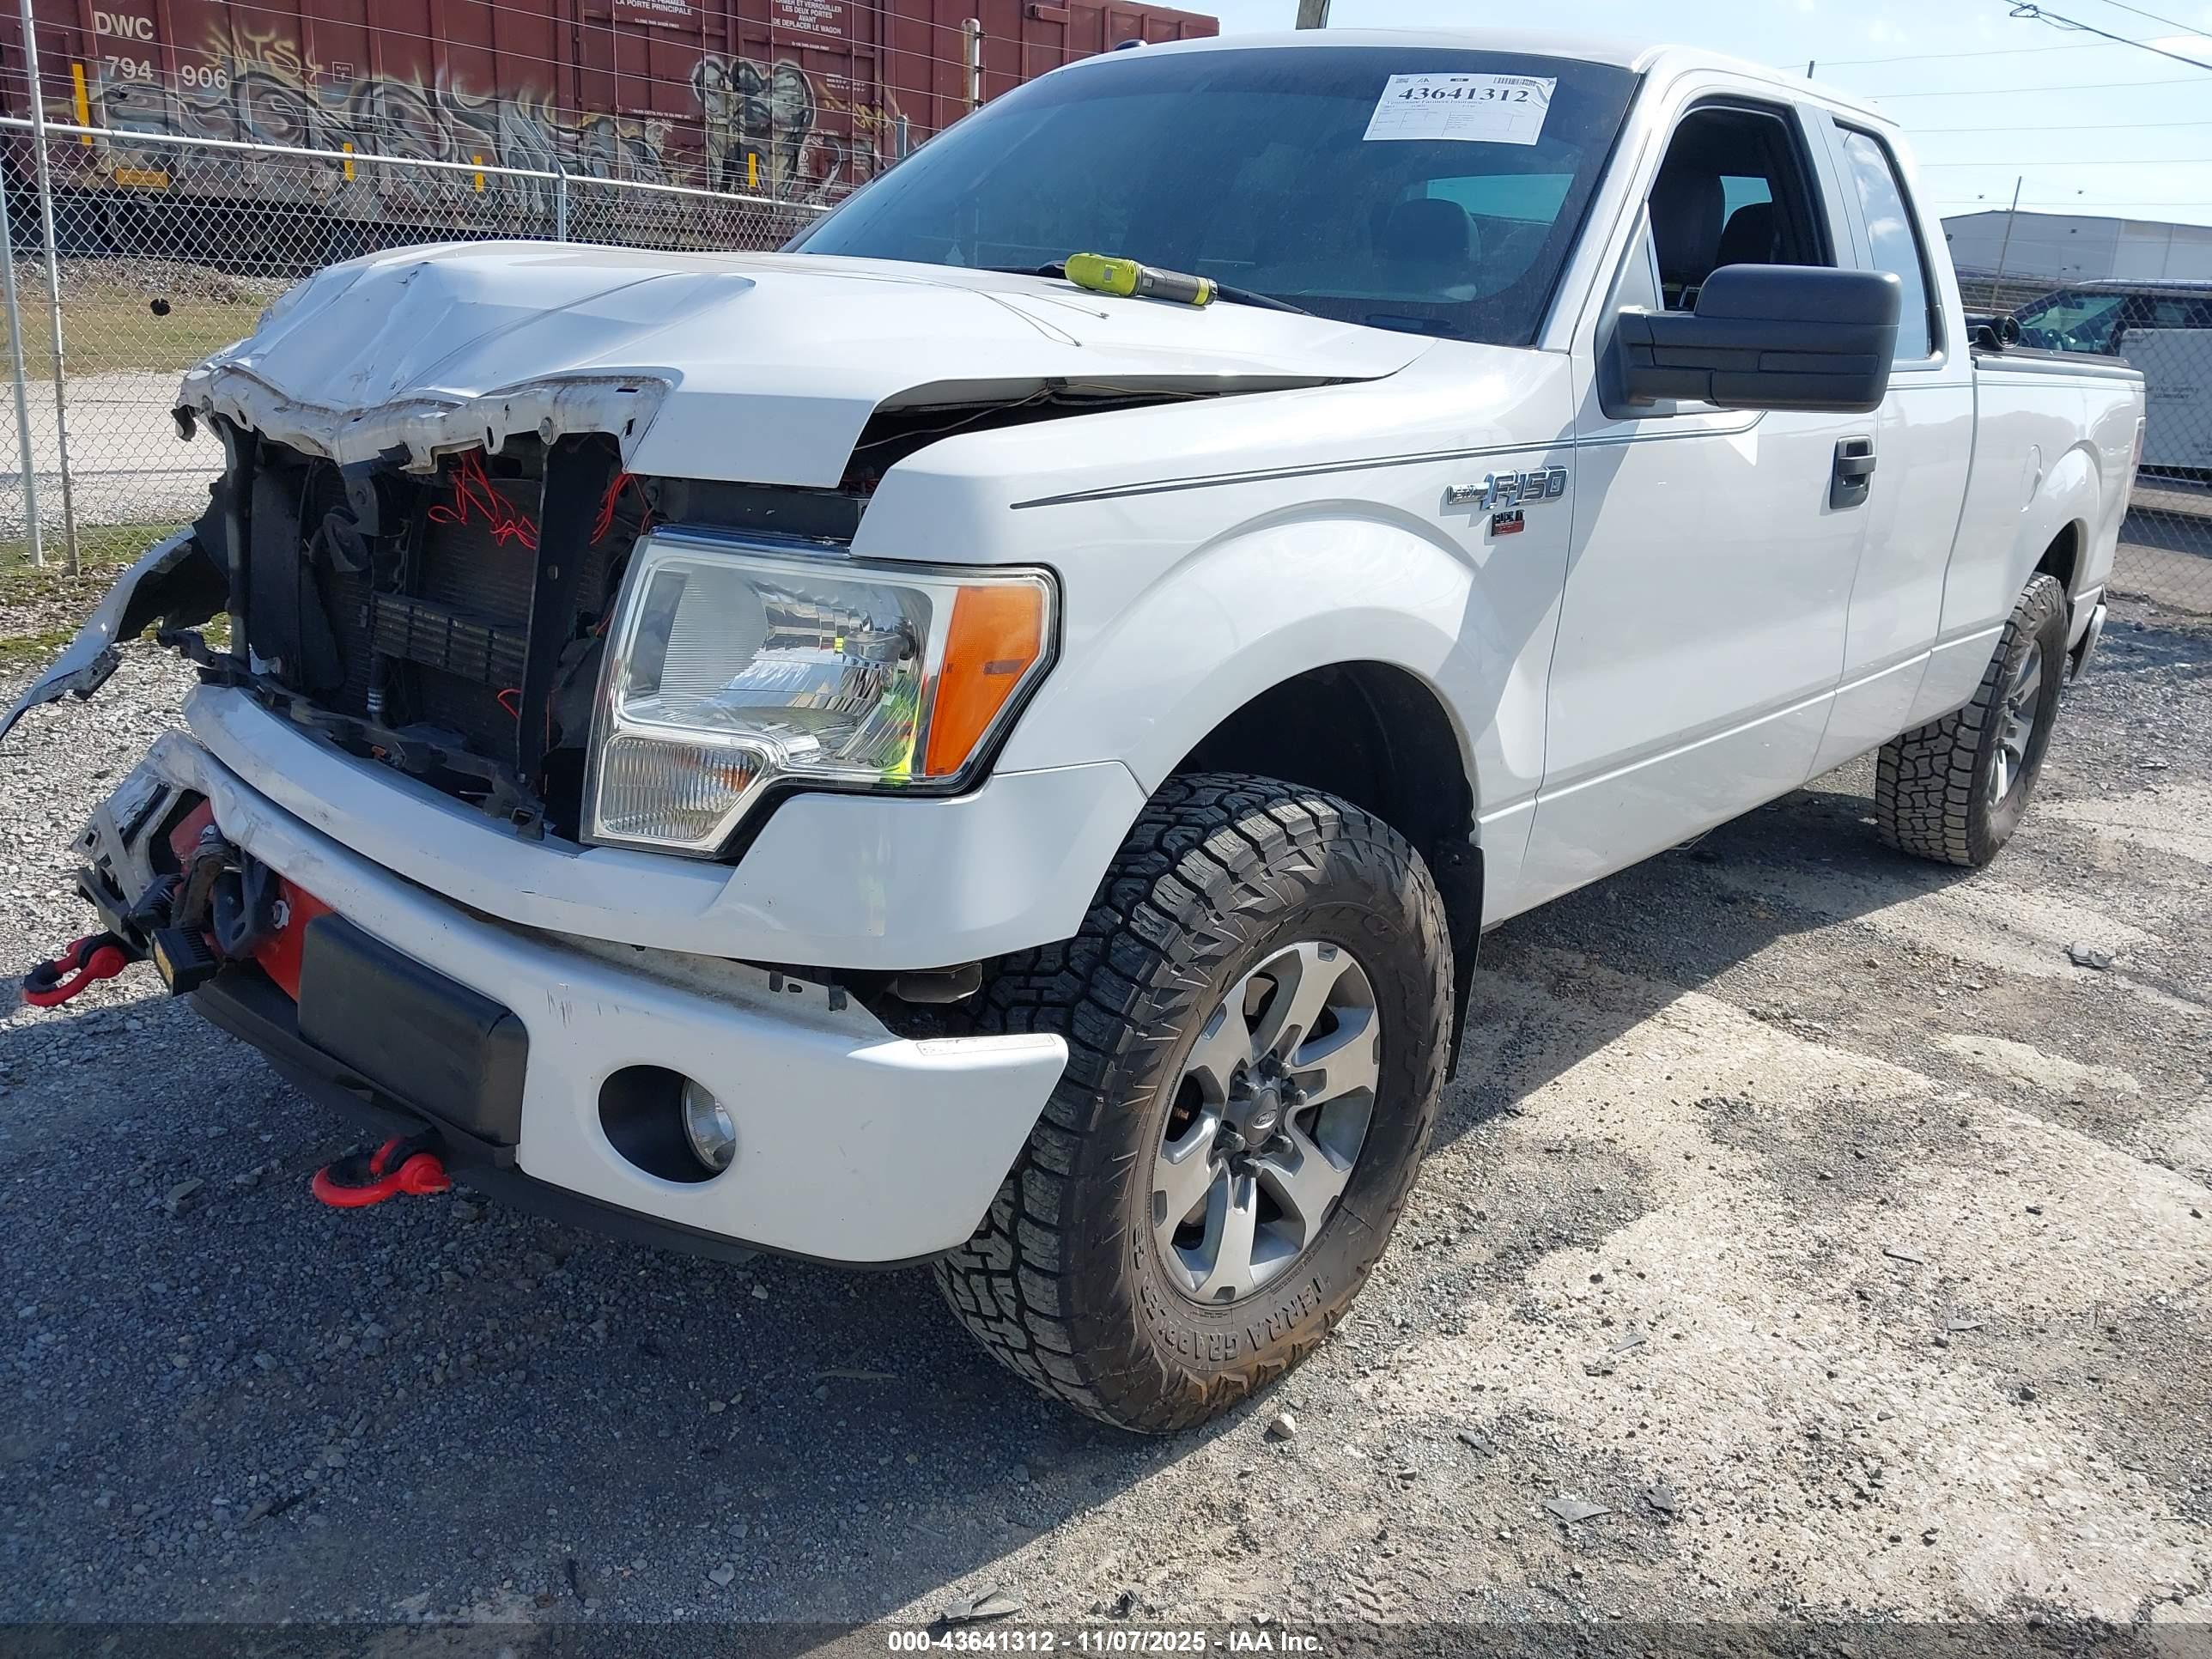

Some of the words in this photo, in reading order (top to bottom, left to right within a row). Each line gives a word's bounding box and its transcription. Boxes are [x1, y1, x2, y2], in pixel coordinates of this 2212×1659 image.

[627, 0, 651, 9] PORTE
[652, 3, 693, 15] PRINCIPALE
[811, 10, 833, 19] PORTES
[93, 11, 154, 40] DWC
[782, 19, 812, 30] DEPLACER
[821, 26, 842, 34] WAGON
[798, 15, 817, 23] AVANT
[104, 55, 154, 82] 794
[181, 64, 228, 90] 906
[1398, 87, 1530, 102] 43641312
